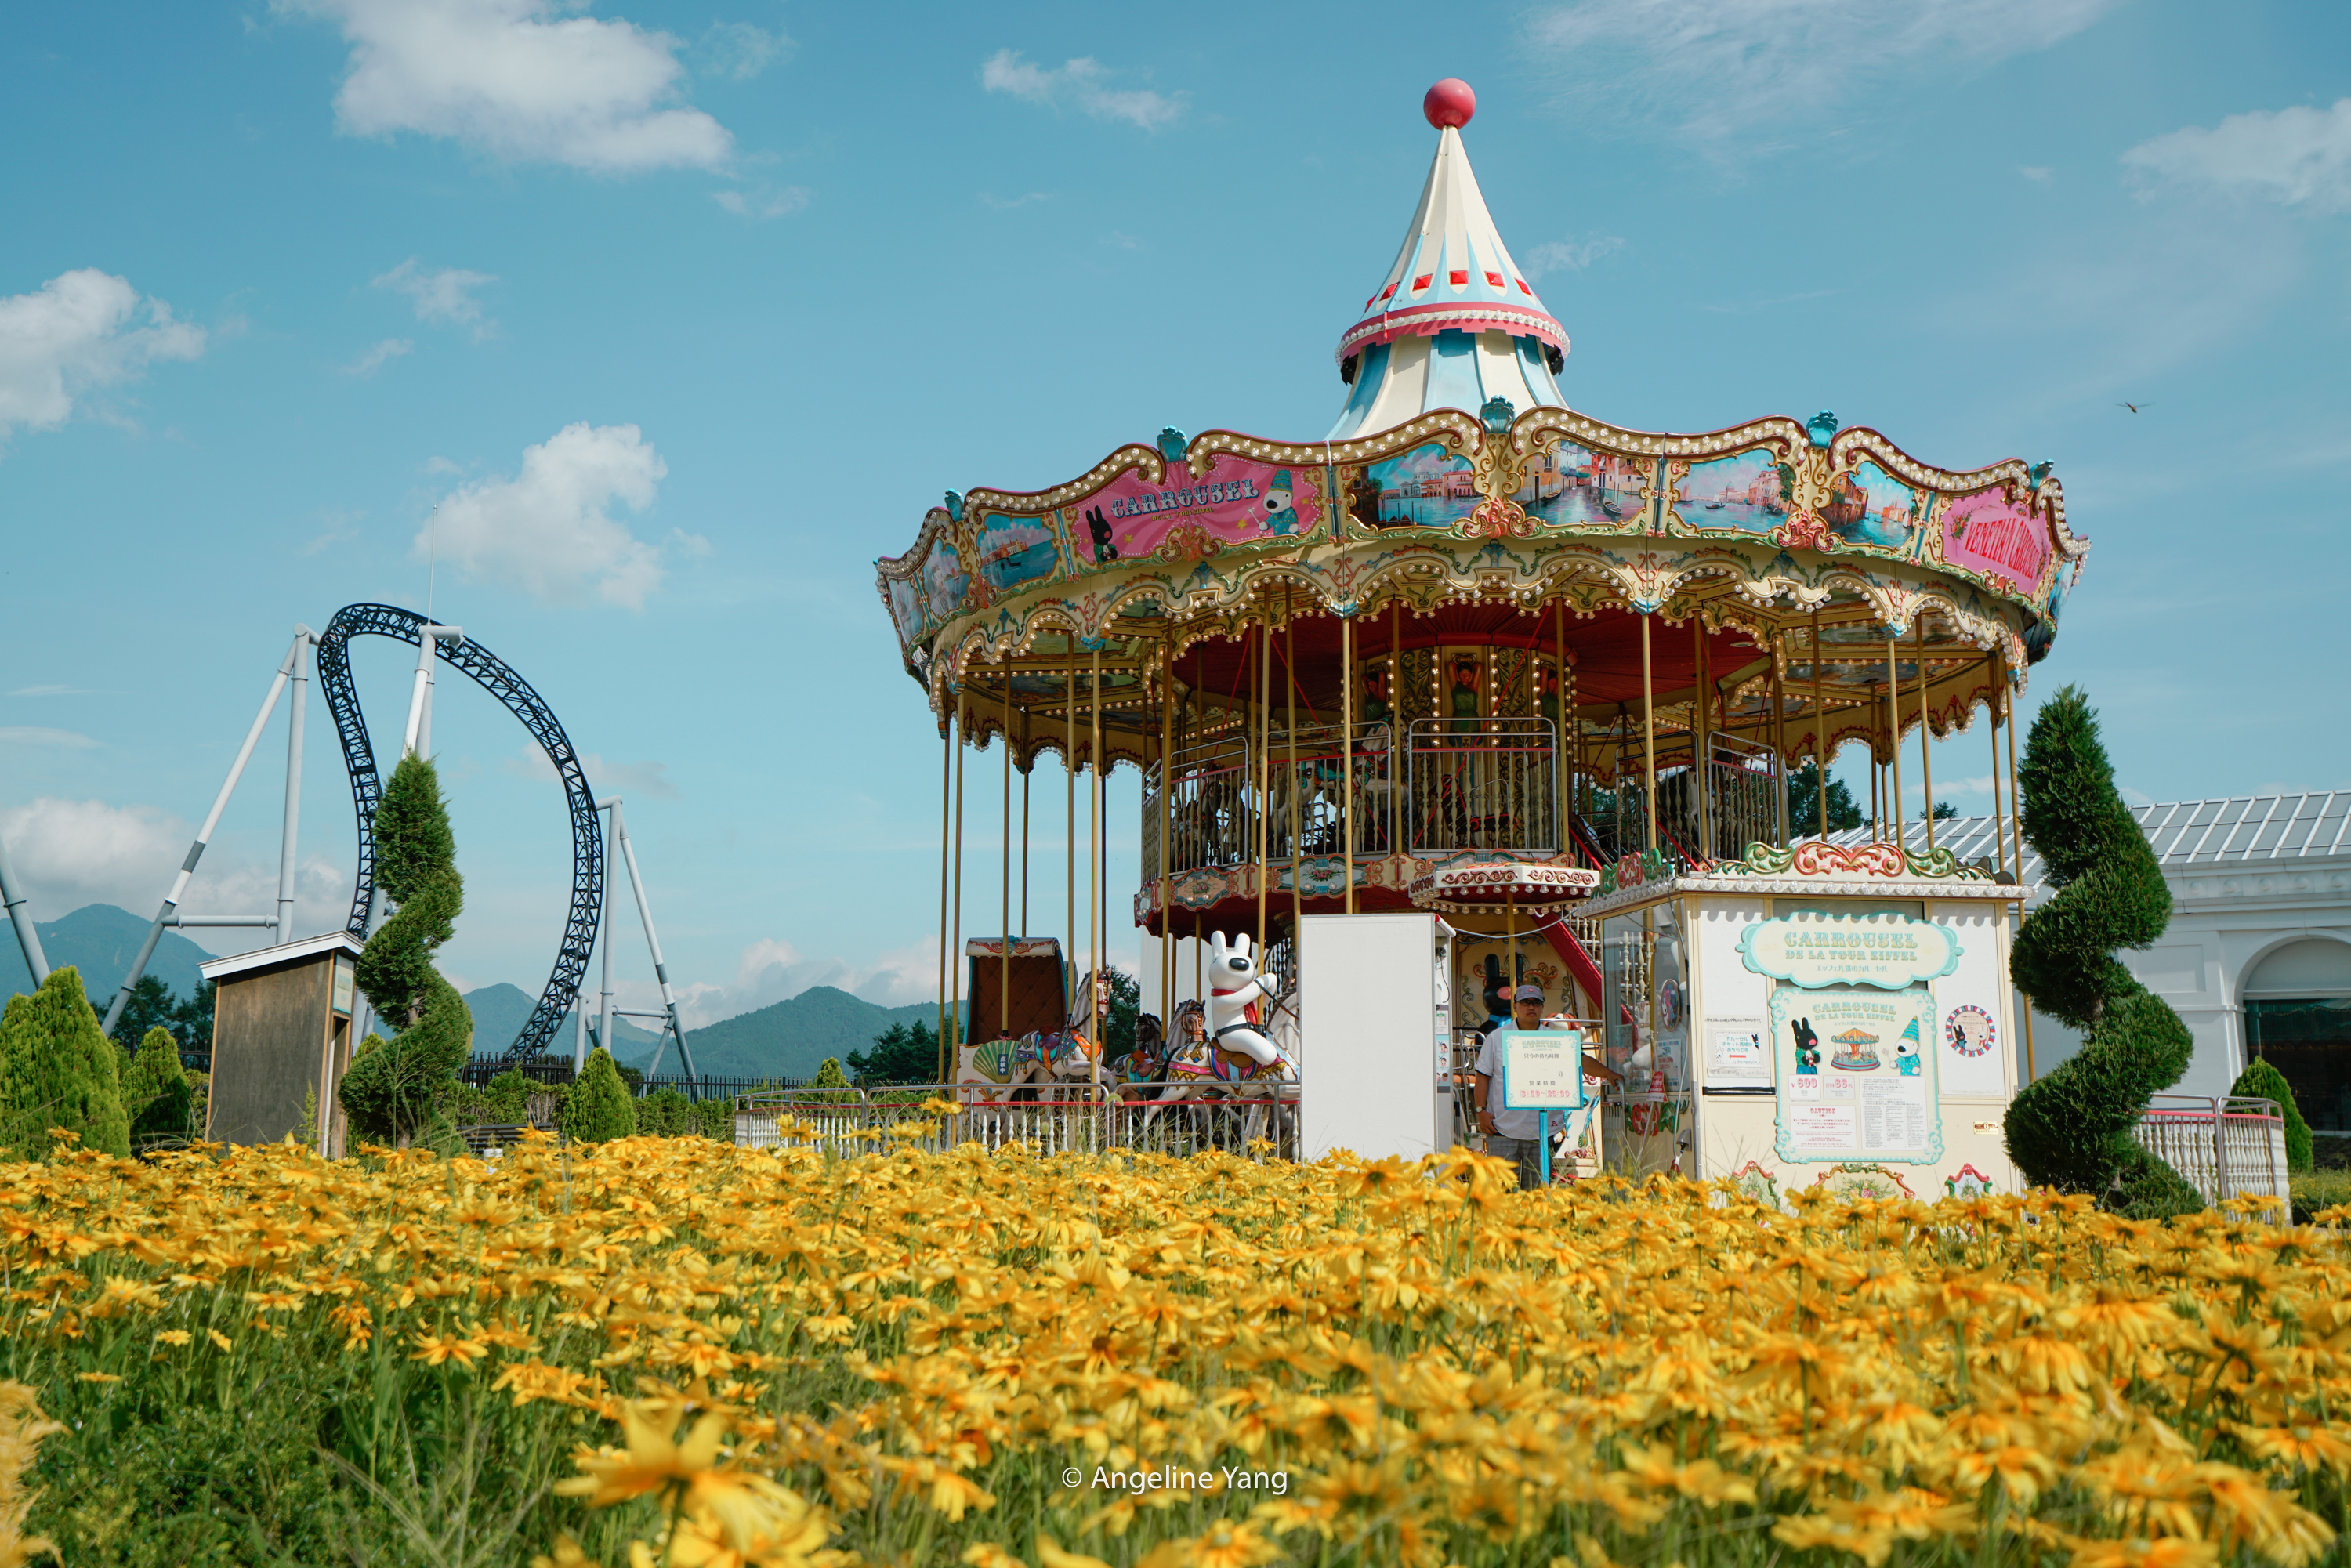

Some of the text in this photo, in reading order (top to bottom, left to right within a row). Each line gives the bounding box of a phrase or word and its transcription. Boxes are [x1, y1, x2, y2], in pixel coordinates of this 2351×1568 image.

[1111, 479, 1259, 518] CARROUSEL
[1965, 518, 2018, 565] VENETIAN
[1784, 931, 1918, 948] CARROUSEL
[1785, 950, 1918, 961] DE LA TOUR EIFFEL
[1812, 1001, 1896, 1015] CARROUSEL
[1866, 1013, 1895, 1022] EIFFEL
